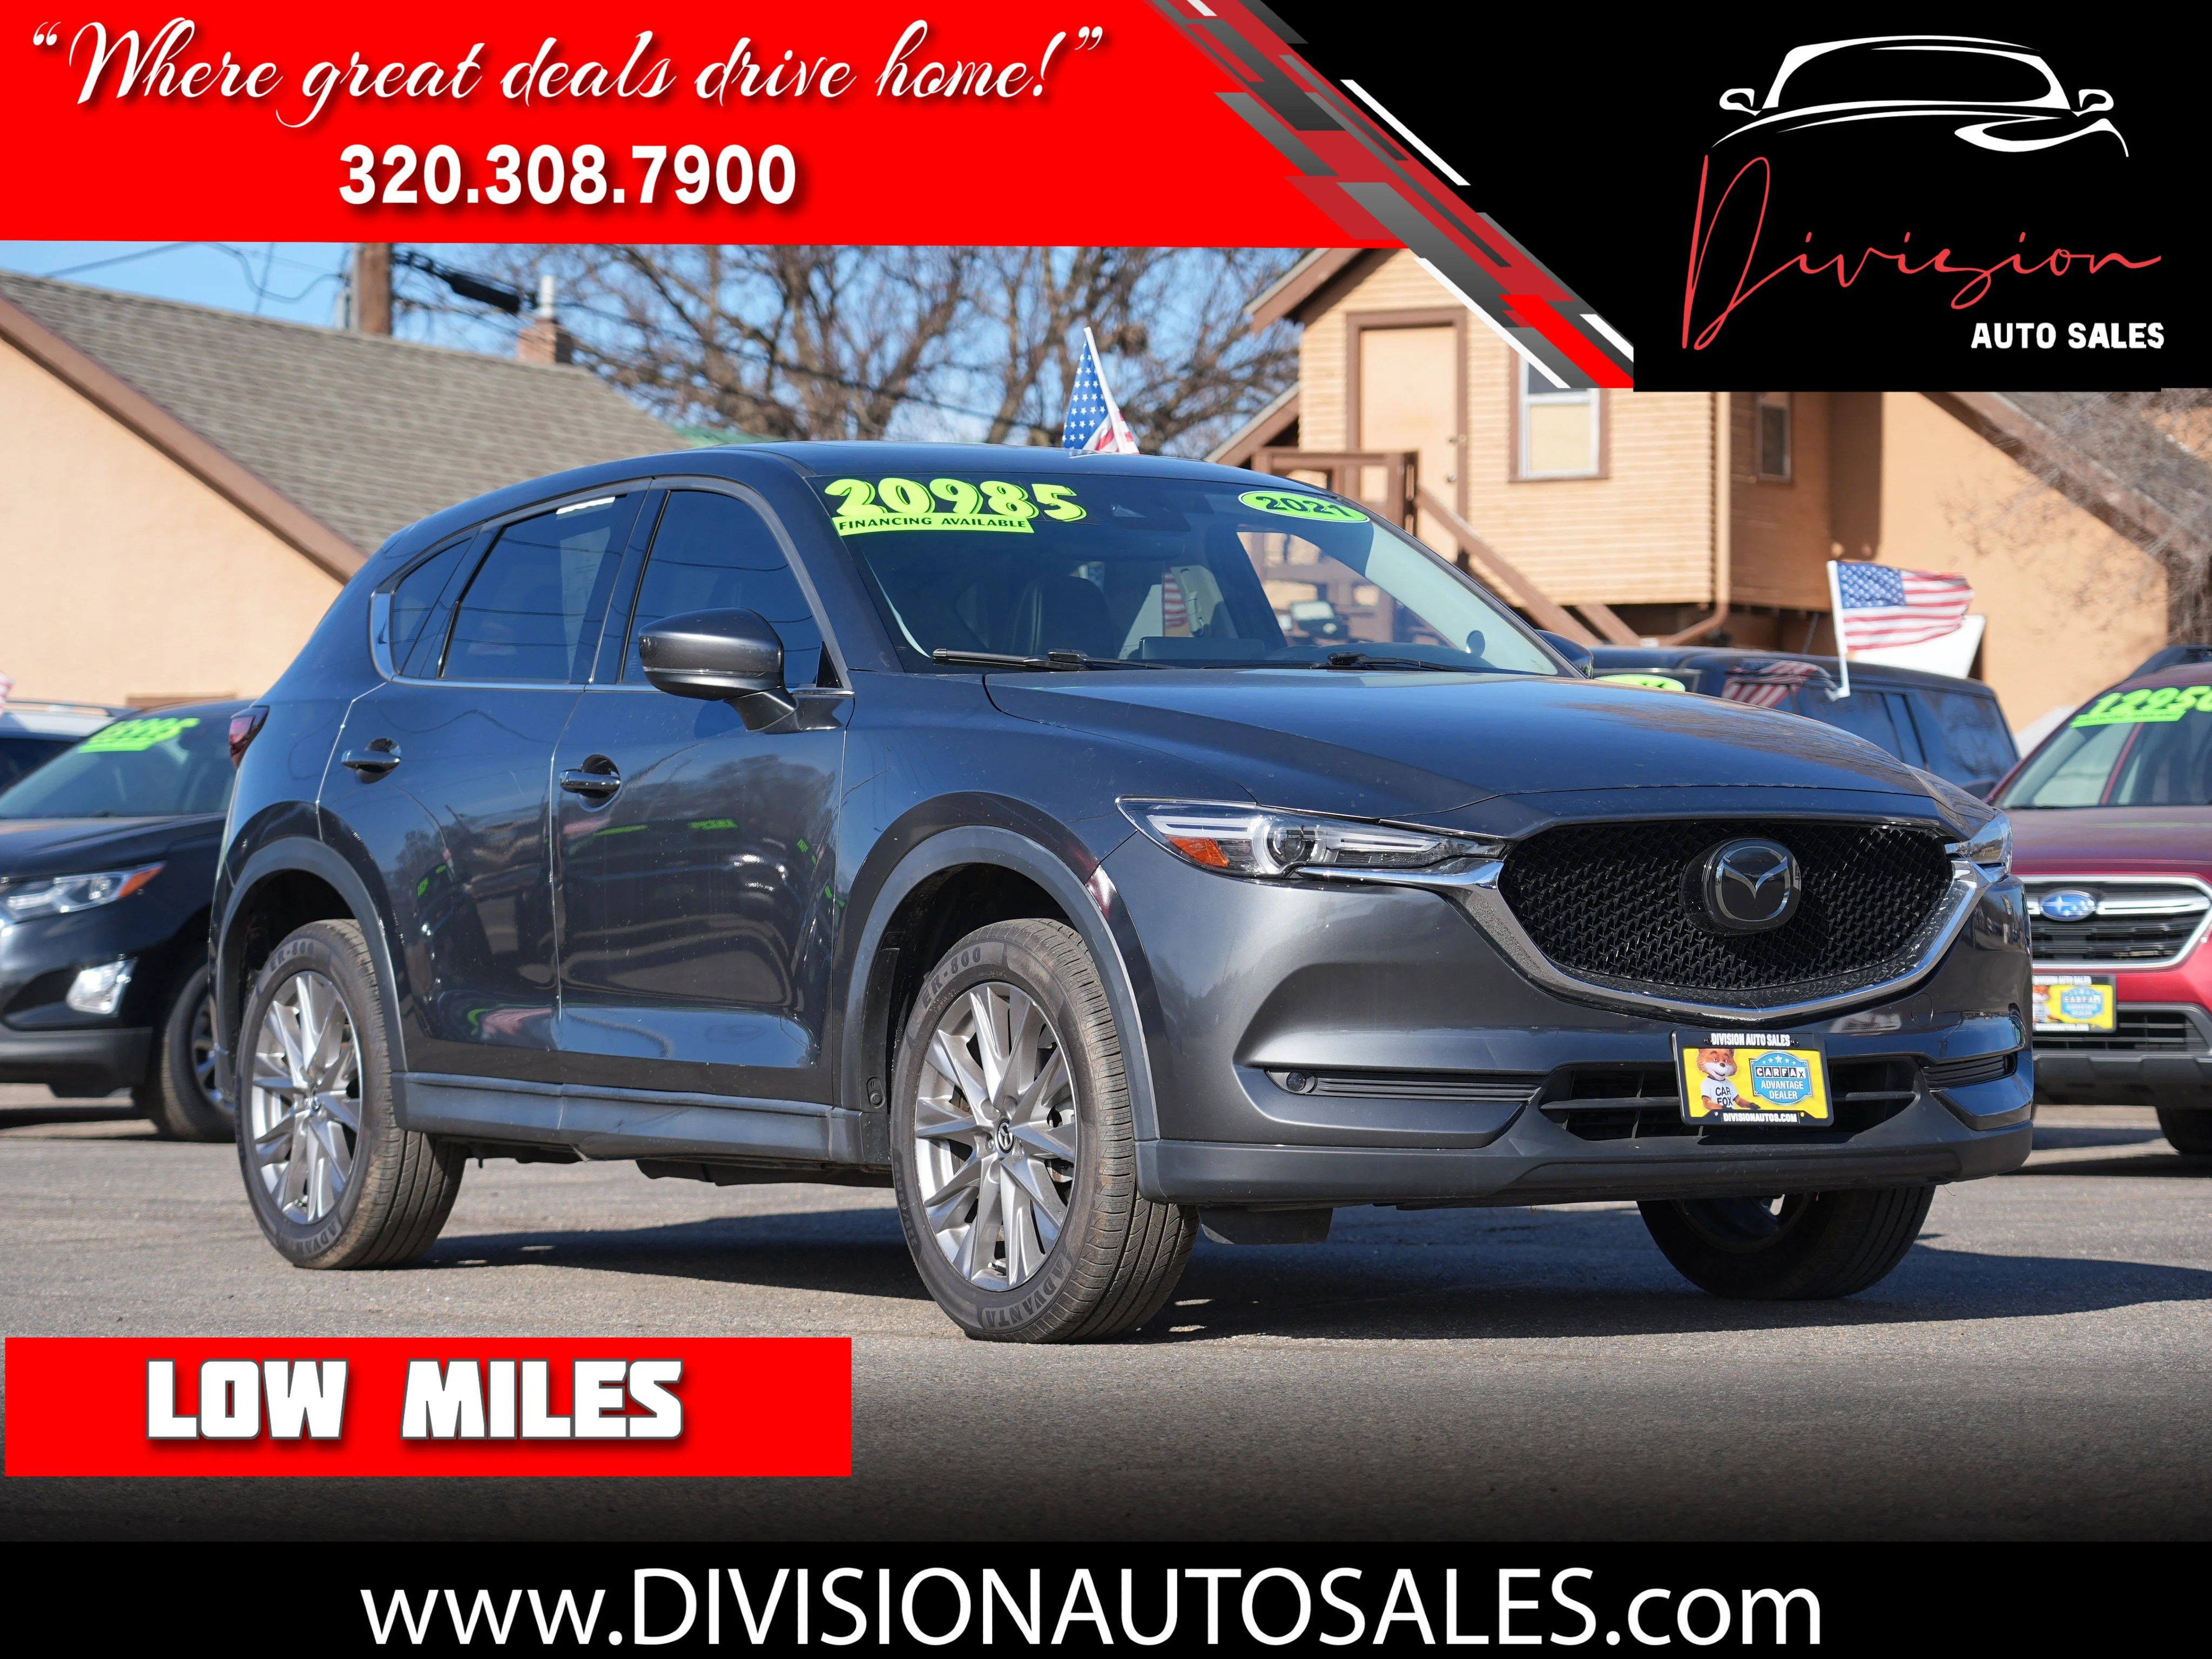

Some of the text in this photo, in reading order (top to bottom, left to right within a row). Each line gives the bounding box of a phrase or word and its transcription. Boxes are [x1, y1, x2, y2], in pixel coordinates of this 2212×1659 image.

[825, 477, 1087, 522] 20985
[1256, 496, 1354, 518] 2021
[839, 517, 1027, 530] FINANCING AVAILABLE
[922, 947, 981, 1009] ER-800
[1711, 1033, 1791, 1047] DIVISION AUTO SALES
[1756, 1067, 1805, 1078] CARFAX
[1761, 1080, 1804, 1090] ADVANTAGE
[1715, 1087, 1731, 1096] CAR
[1769, 1090, 1798, 1100] DEALER
[1717, 1096, 1733, 1107] FOX
[1723, 1112, 1797, 1123] DIVISIONAUTOS.COM
[986, 1257, 1065, 1327] ADVANTA
